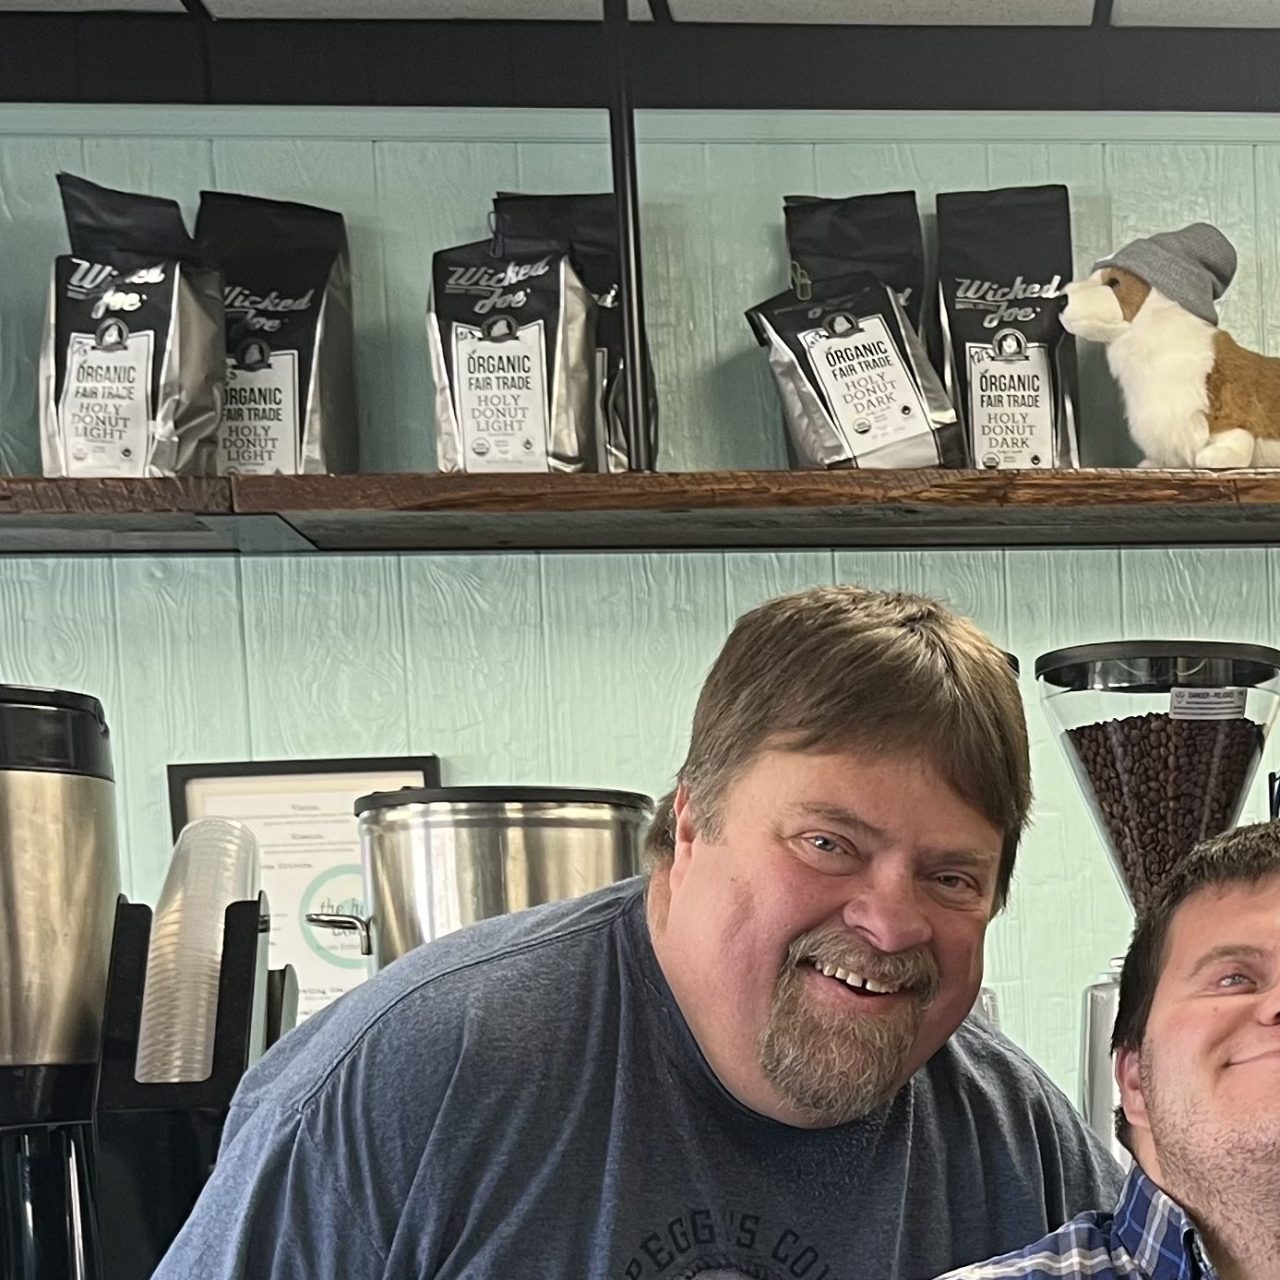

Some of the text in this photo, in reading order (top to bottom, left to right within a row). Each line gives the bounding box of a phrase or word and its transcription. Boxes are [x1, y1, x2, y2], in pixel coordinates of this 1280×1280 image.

[448, 255, 553, 287] Wicked
[955, 275, 1062, 301] Wicked
[473, 288, 528, 314] Joe
[983, 302, 1036, 329] Joe
[826, 341, 888, 367] ORGANIC
[467, 355, 531, 374] ORGANIC
[832, 356, 893, 381] FAIR TRADE
[77, 365, 136, 384] ORGANIC
[844, 372, 885, 391] HOLY
[468, 375, 532, 391] FAIR TRADE
[980, 374, 1040, 392] ORGANIC
[842, 380, 896, 404] DONUT
[478, 395, 521, 406] HOLY
[853, 392, 896, 414] DARK
[980, 395, 1040, 408] FAIR TRADE
[80, 402, 121, 415] HOLY
[247, 408, 282, 422] TRADE
[471, 407, 529, 419] DONUT
[72, 413, 130, 428] DONUT
[476, 420, 525, 431] LIGHT
[987, 413, 1028, 424] HOLY
[75, 427, 126, 440] LIGHT
[228, 425, 270, 437] HOLY
[981, 425, 1036, 436] DONUT
[223, 438, 279, 449] DONUT
[989, 437, 1030, 448] DARK
[227, 450, 275, 461] LIGHT
